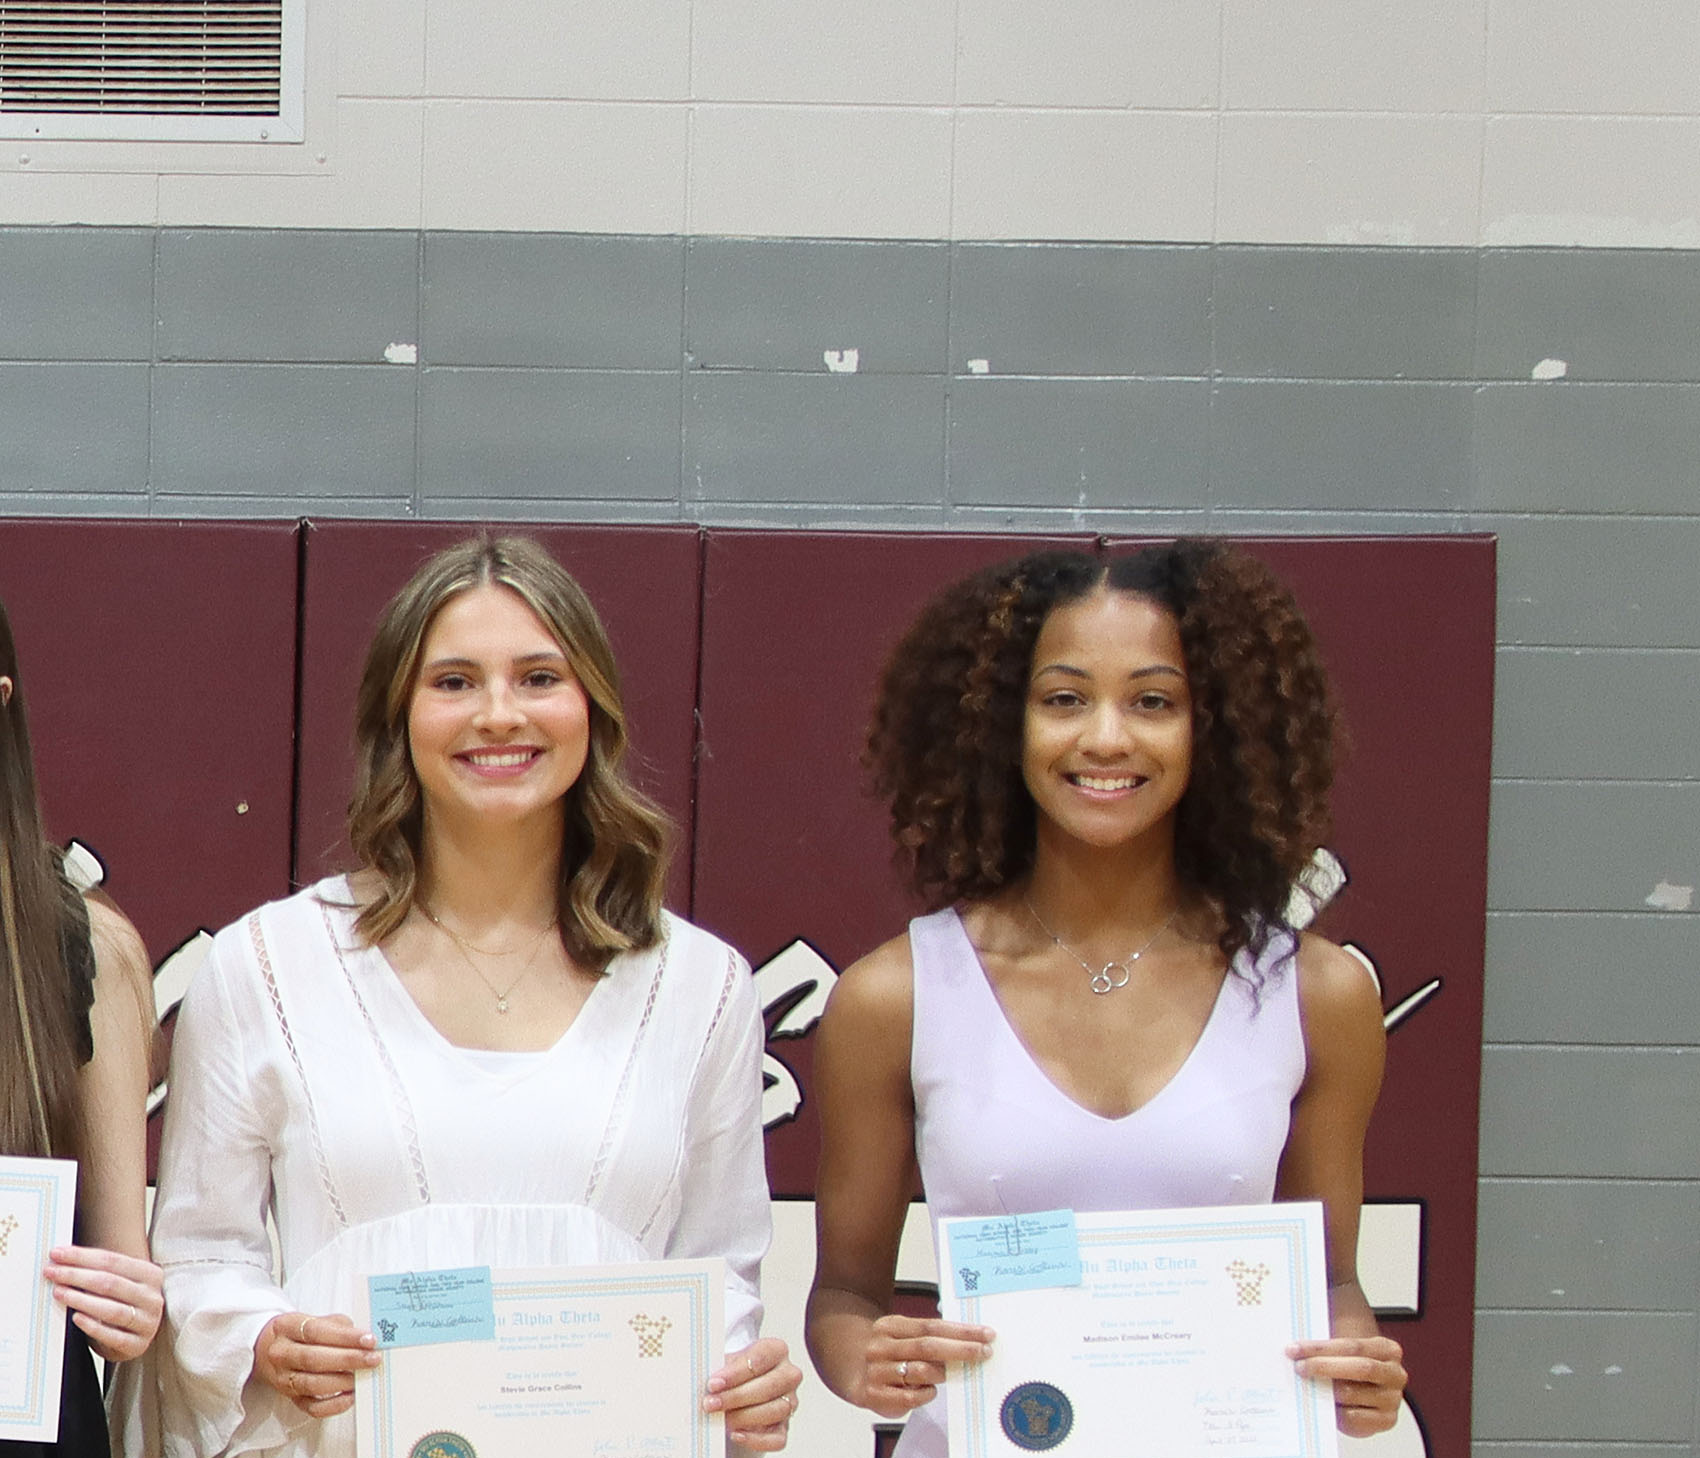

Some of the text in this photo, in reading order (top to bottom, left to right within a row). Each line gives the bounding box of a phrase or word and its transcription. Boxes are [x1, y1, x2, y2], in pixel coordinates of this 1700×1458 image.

[1105, 1259, 1148, 1274] Alpha
[1154, 1257, 1197, 1271] Theta
[512, 1312, 553, 1327] Alpha
[559, 1310, 600, 1324] Theta
[1082, 1335, 1119, 1343] Madison
[1152, 1332, 1192, 1340] McCreary
